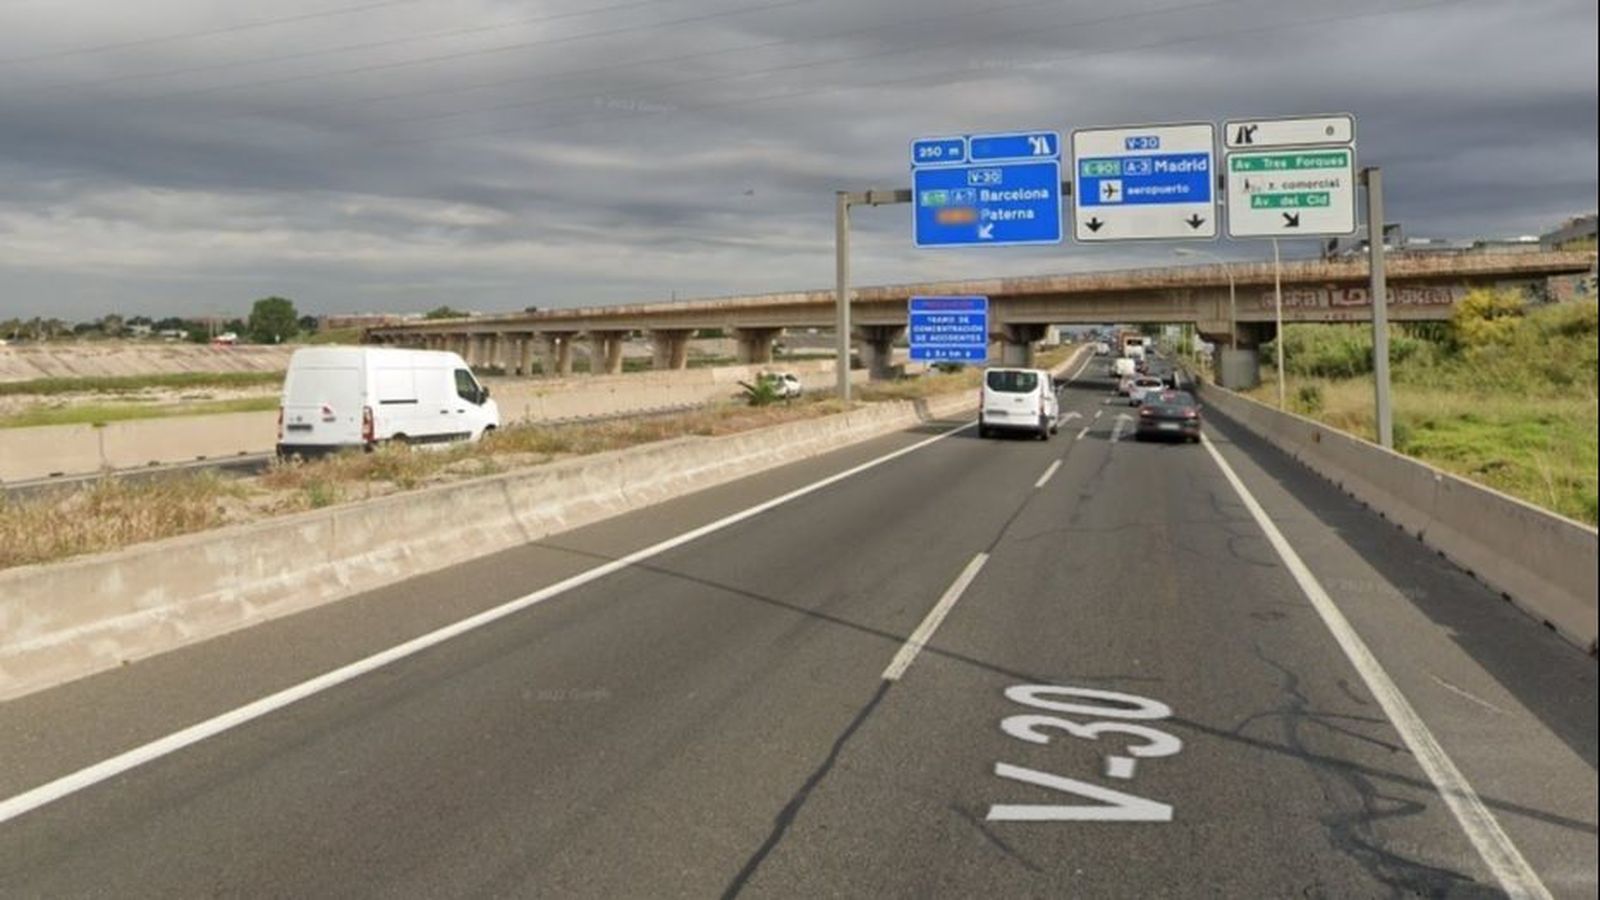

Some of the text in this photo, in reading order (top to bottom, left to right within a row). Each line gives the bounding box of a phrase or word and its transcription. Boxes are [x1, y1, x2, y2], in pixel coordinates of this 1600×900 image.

[1127, 137, 1158, 148] V-30
[949, 147, 959, 155] m
[1154, 159, 1207, 172] Madrid
[1263, 158, 1287, 168] Tres
[1296, 156, 1344, 168] Forques
[970, 172, 1000, 183] V-30
[1127, 183, 1191, 196] aeropuerto
[1282, 179, 1340, 190] comercial
[980, 187, 1049, 201] Barcelona
[1280, 196, 1299, 205] del
[1306, 195, 1328, 205] Cid
[980, 208, 1035, 221] Paterna
[986, 684, 1183, 821] V-30
